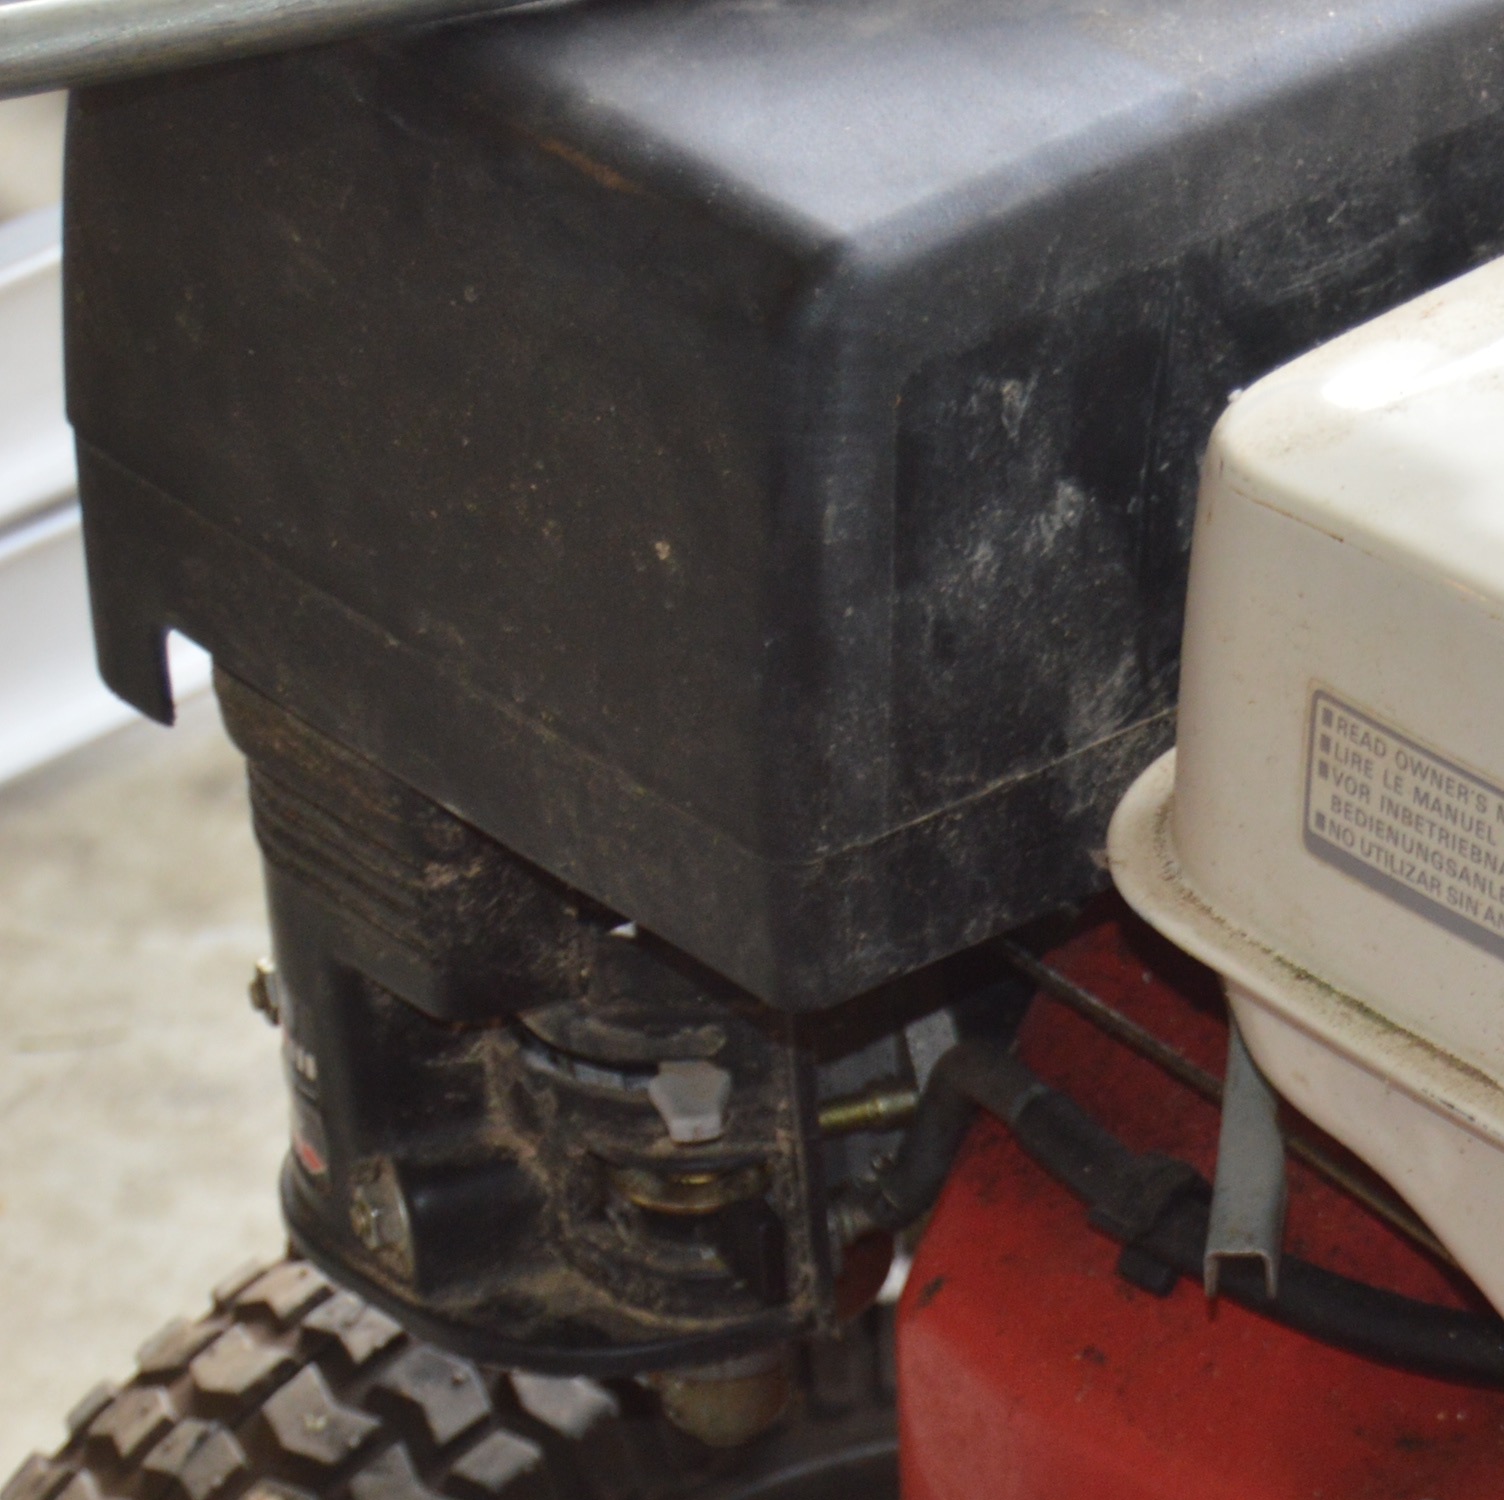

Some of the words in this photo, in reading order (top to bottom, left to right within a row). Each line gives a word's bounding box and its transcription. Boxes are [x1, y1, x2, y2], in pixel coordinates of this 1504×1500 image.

[1331, 767, 1369, 804] VOR
[1334, 742, 1372, 779] LIRE
[1383, 769, 1402, 796] LE
[1413, 786, 1496, 847] MANUEL
[1336, 715, 1386, 759] READ
[1394, 748, 1487, 815] OWNER'S
[1328, 818, 1354, 849] NO
[1360, 836, 1441, 897] UTILIZAR
[1446, 883, 1478, 917] SIN
